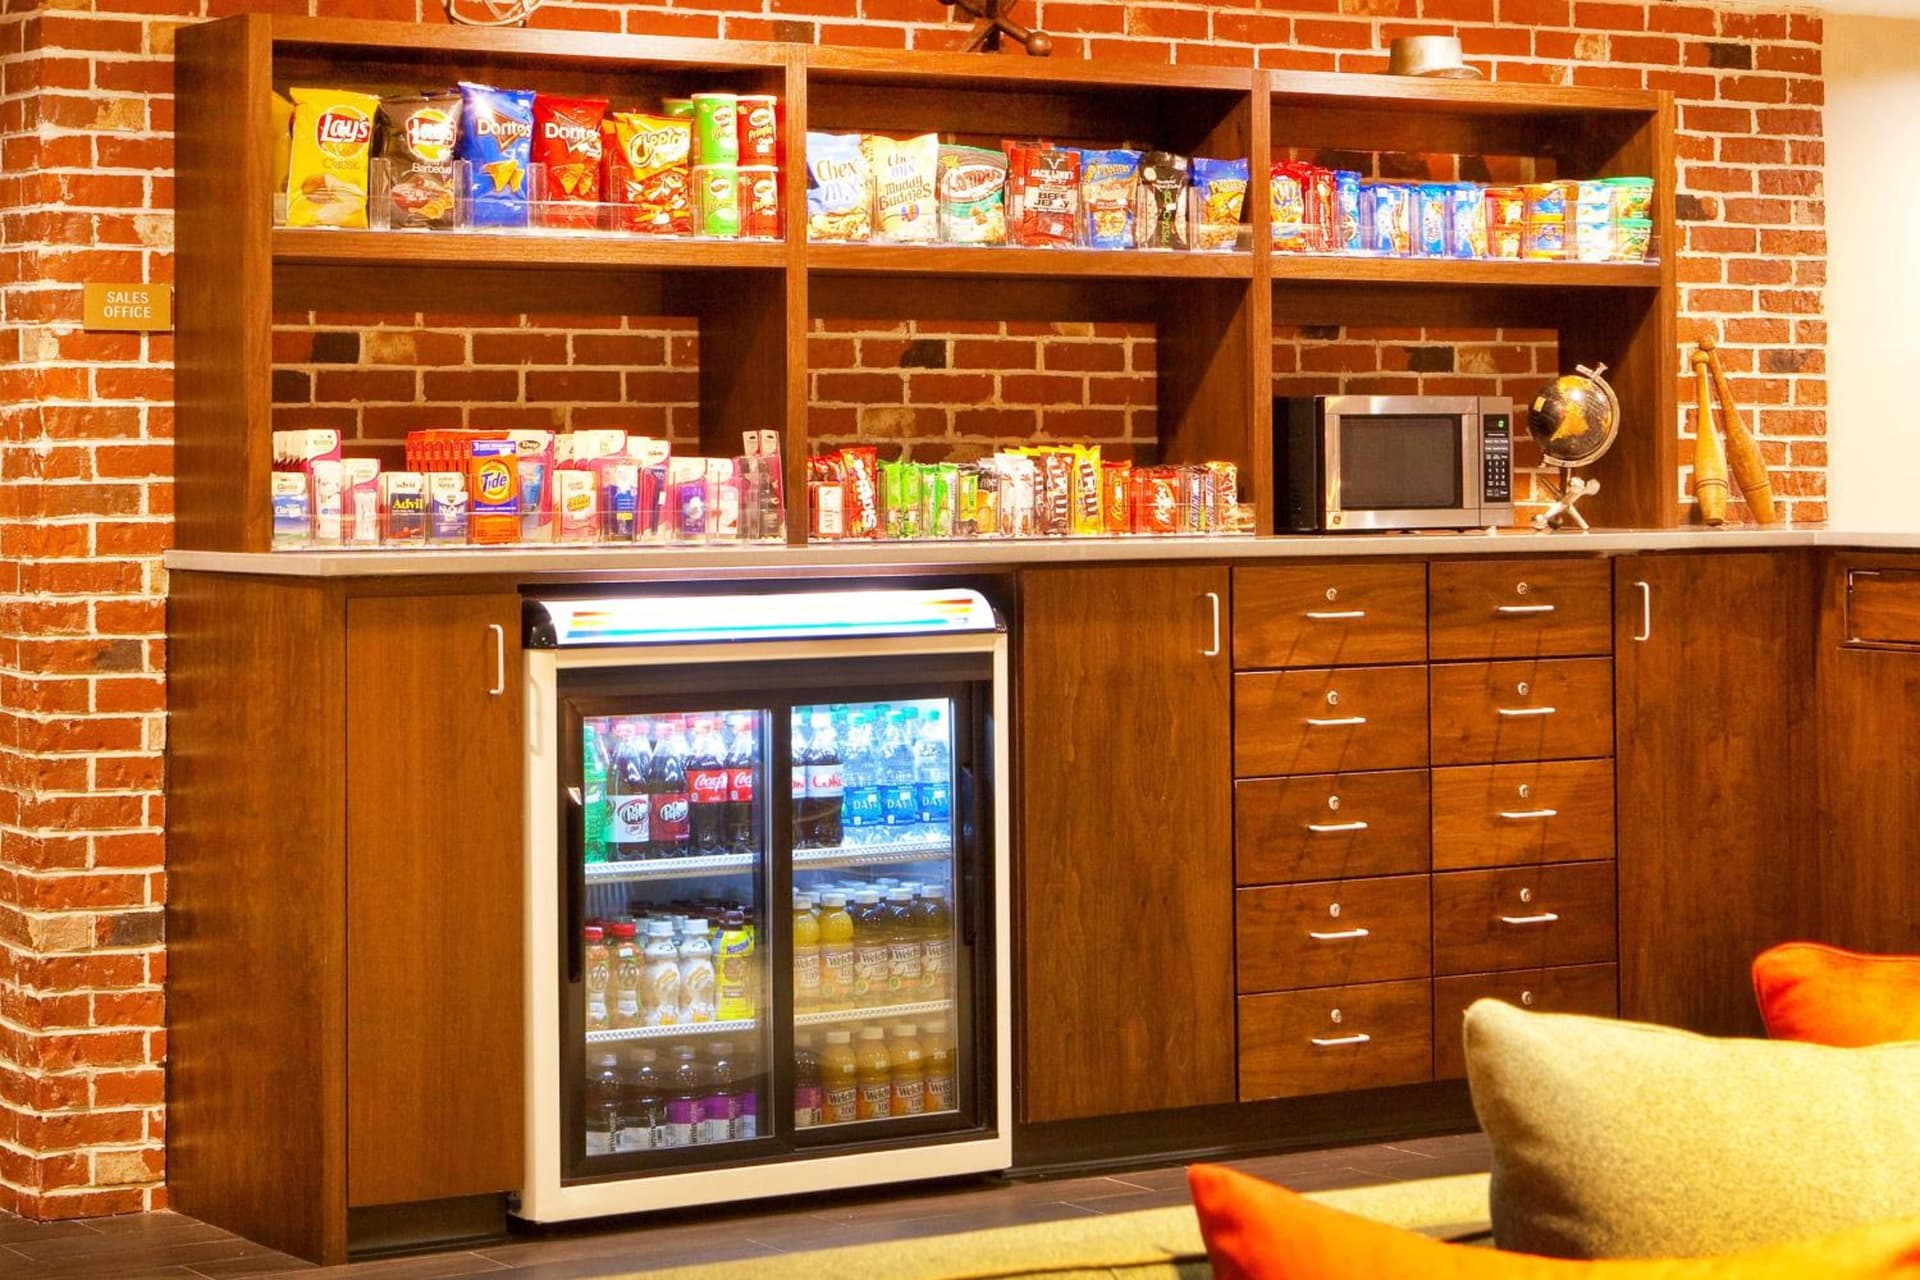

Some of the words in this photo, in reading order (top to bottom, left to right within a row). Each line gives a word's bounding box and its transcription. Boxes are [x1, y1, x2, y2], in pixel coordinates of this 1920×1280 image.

[320, 113, 370, 143] Lay's
[477, 117, 532, 137] Doritos
[816, 159, 857, 182] Chex
[106, 291, 149, 304] SALES
[103, 306, 152, 318] OFFICE
[481, 471, 508, 493] Tide
[393, 500, 424, 511] Advil
